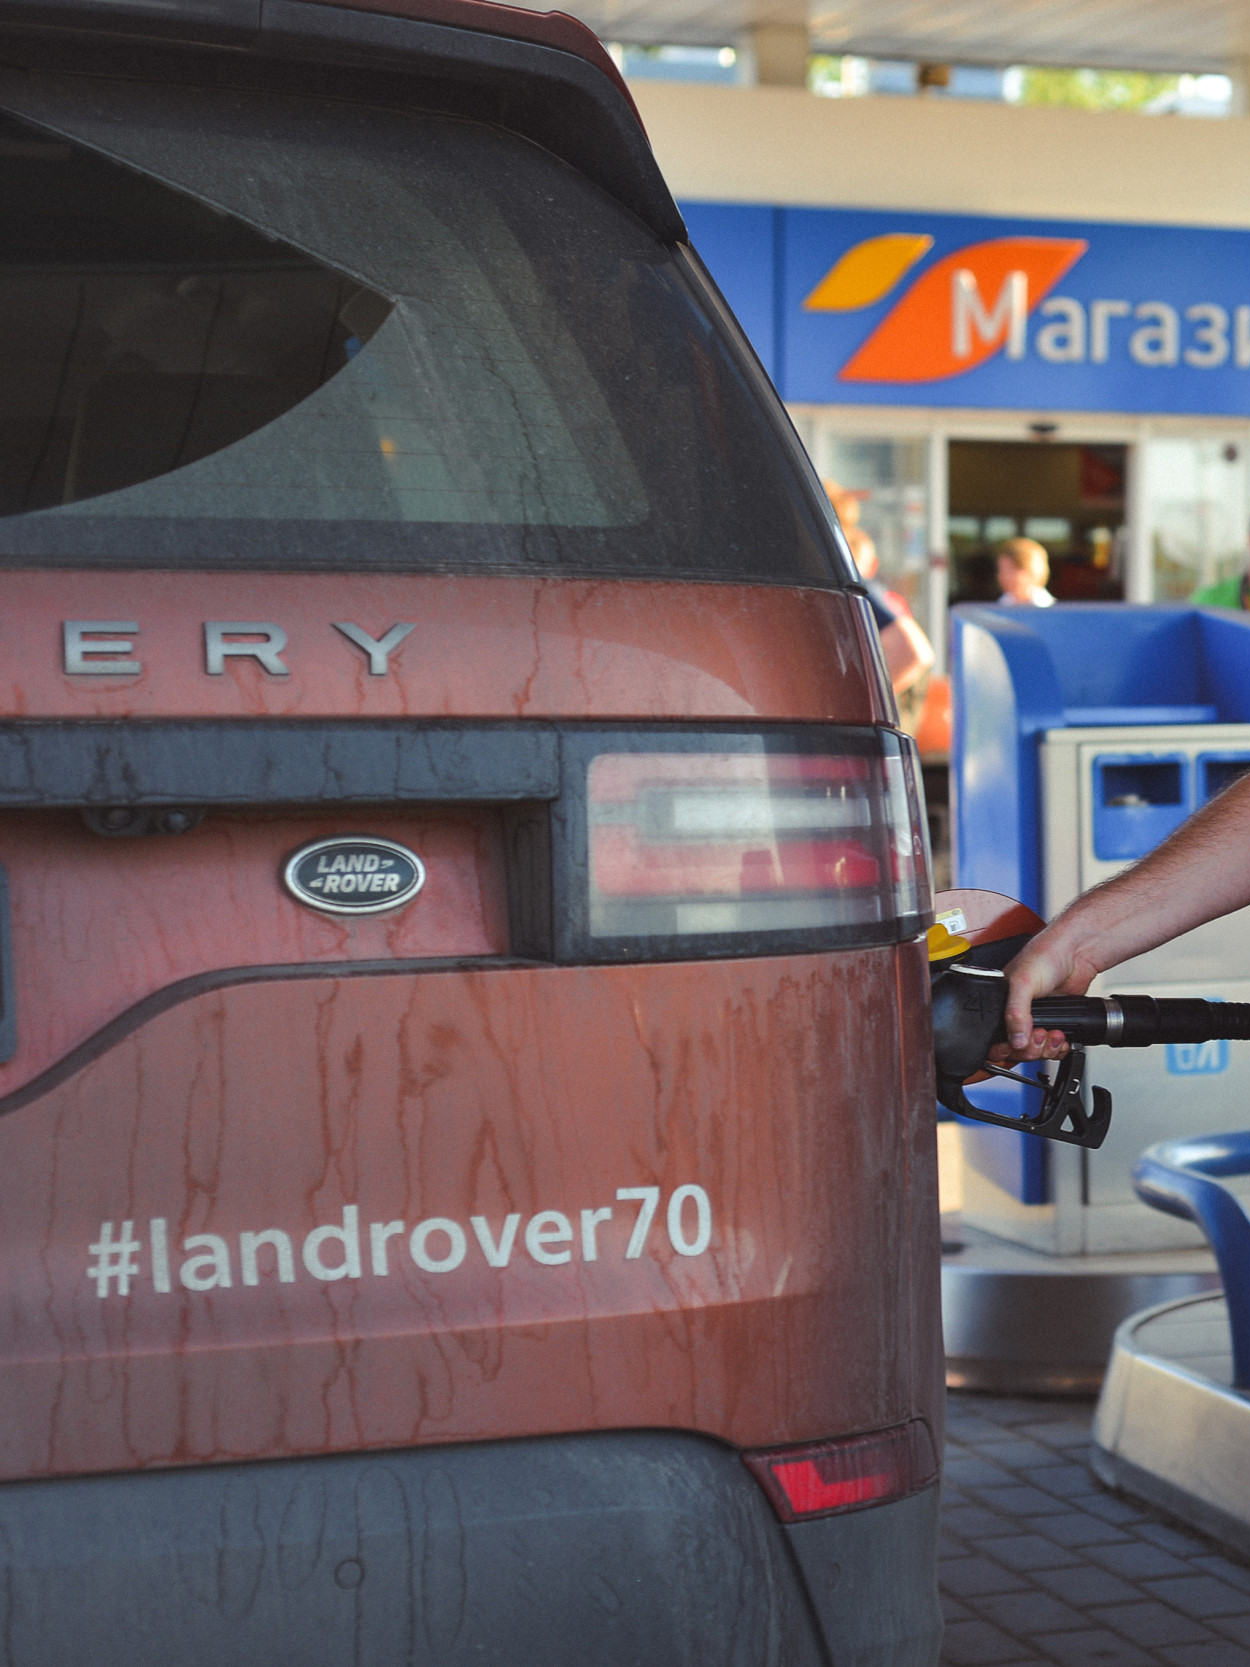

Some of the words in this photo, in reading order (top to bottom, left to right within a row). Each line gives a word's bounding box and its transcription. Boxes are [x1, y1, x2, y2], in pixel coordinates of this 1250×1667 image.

[63, 620, 418, 676] ERY
[317, 854, 381, 873] LAND
[323, 873, 401, 893] ROVER
[86, 1183, 713, 1298] #landrover70
